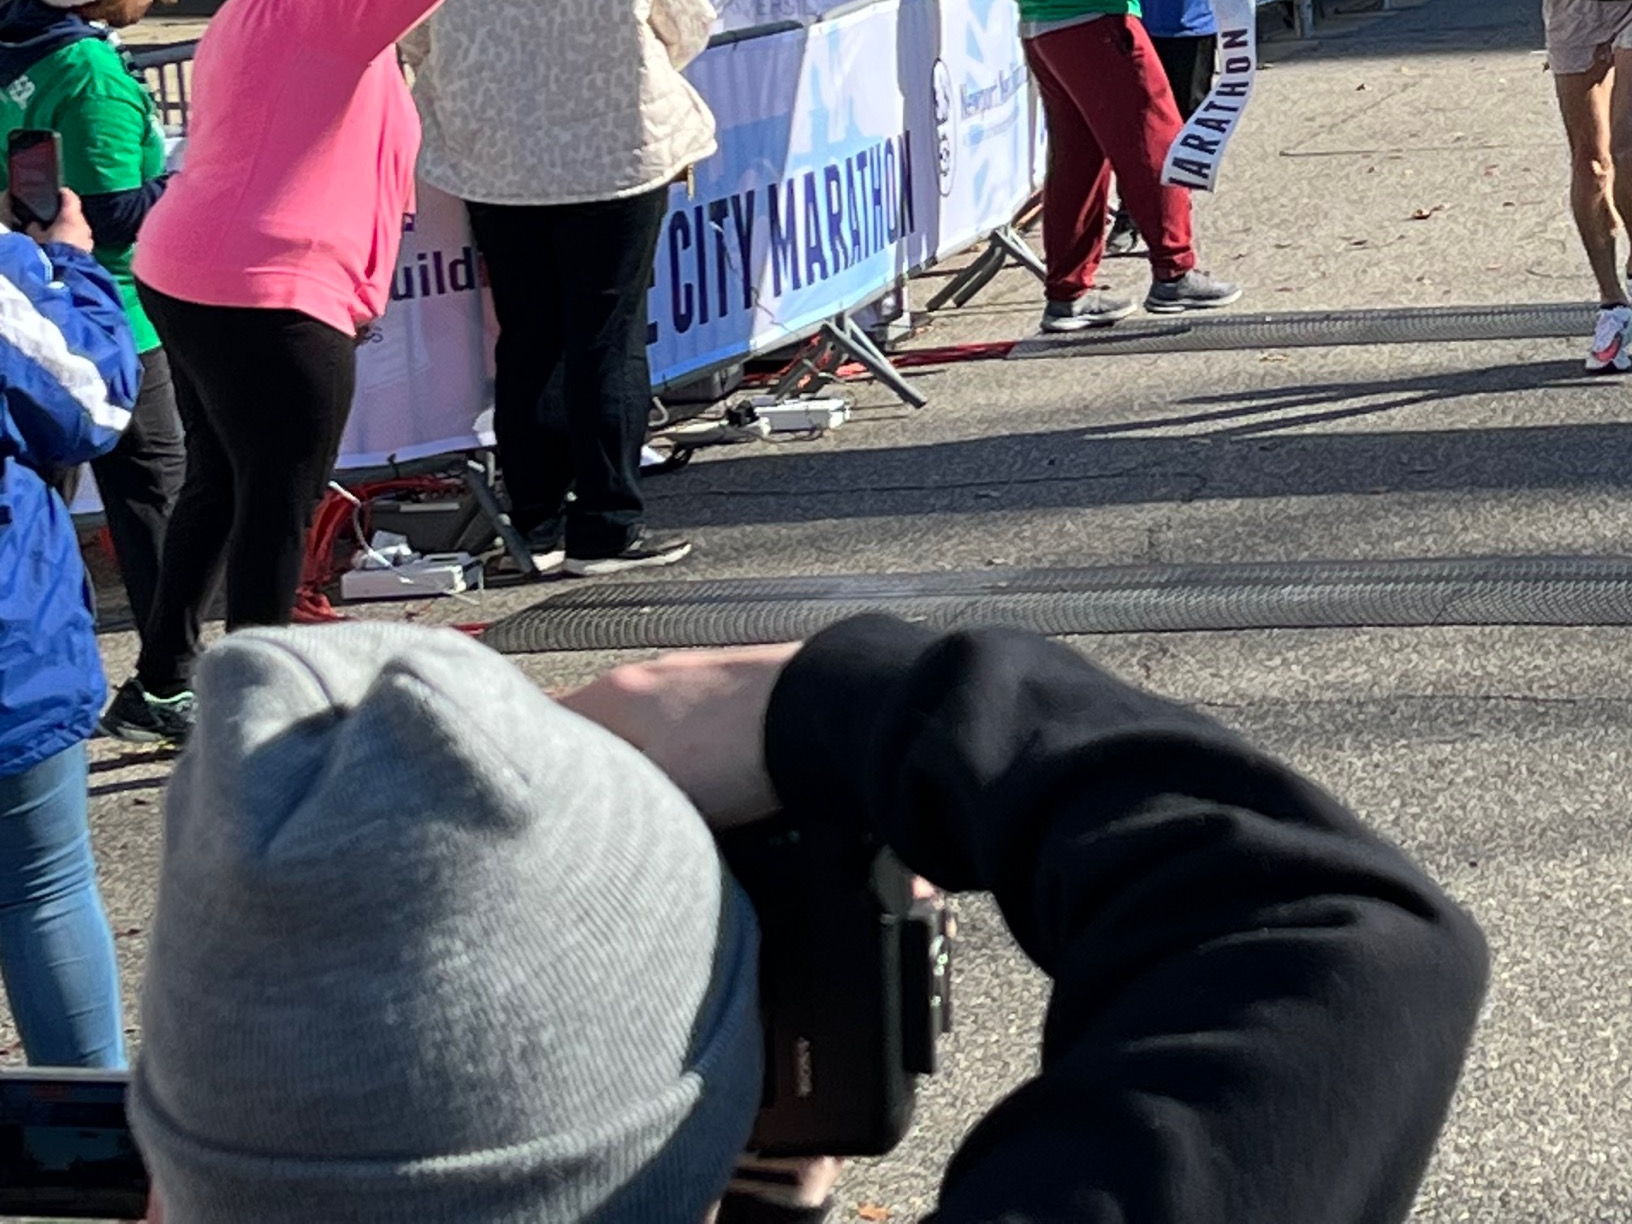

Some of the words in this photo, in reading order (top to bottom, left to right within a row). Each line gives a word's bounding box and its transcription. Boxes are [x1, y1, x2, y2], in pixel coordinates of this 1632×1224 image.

[391, 246, 475, 301] uild
[668, 189, 755, 334] CITY
[767, 129, 915, 298] MARATHON
